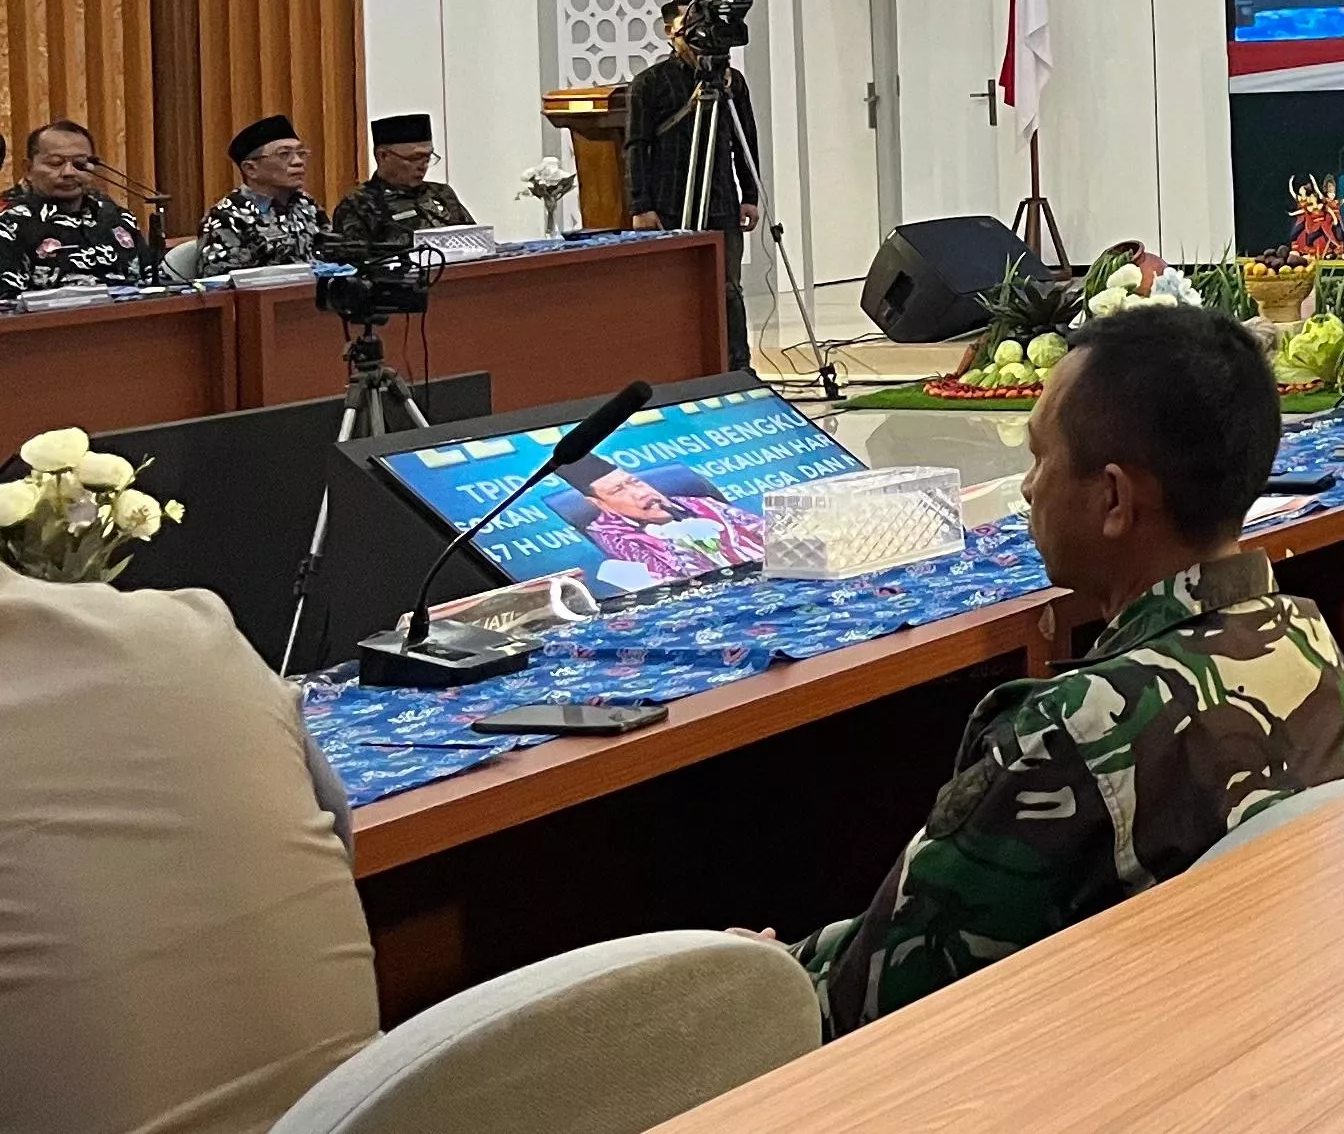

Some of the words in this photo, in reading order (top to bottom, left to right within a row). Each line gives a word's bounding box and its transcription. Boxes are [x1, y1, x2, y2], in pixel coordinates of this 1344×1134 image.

[704, 411, 808, 447] BENGKU
[511, 538, 542, 556] H
[535, 526, 582, 549] UN
[797, 457, 847, 479] DAN
